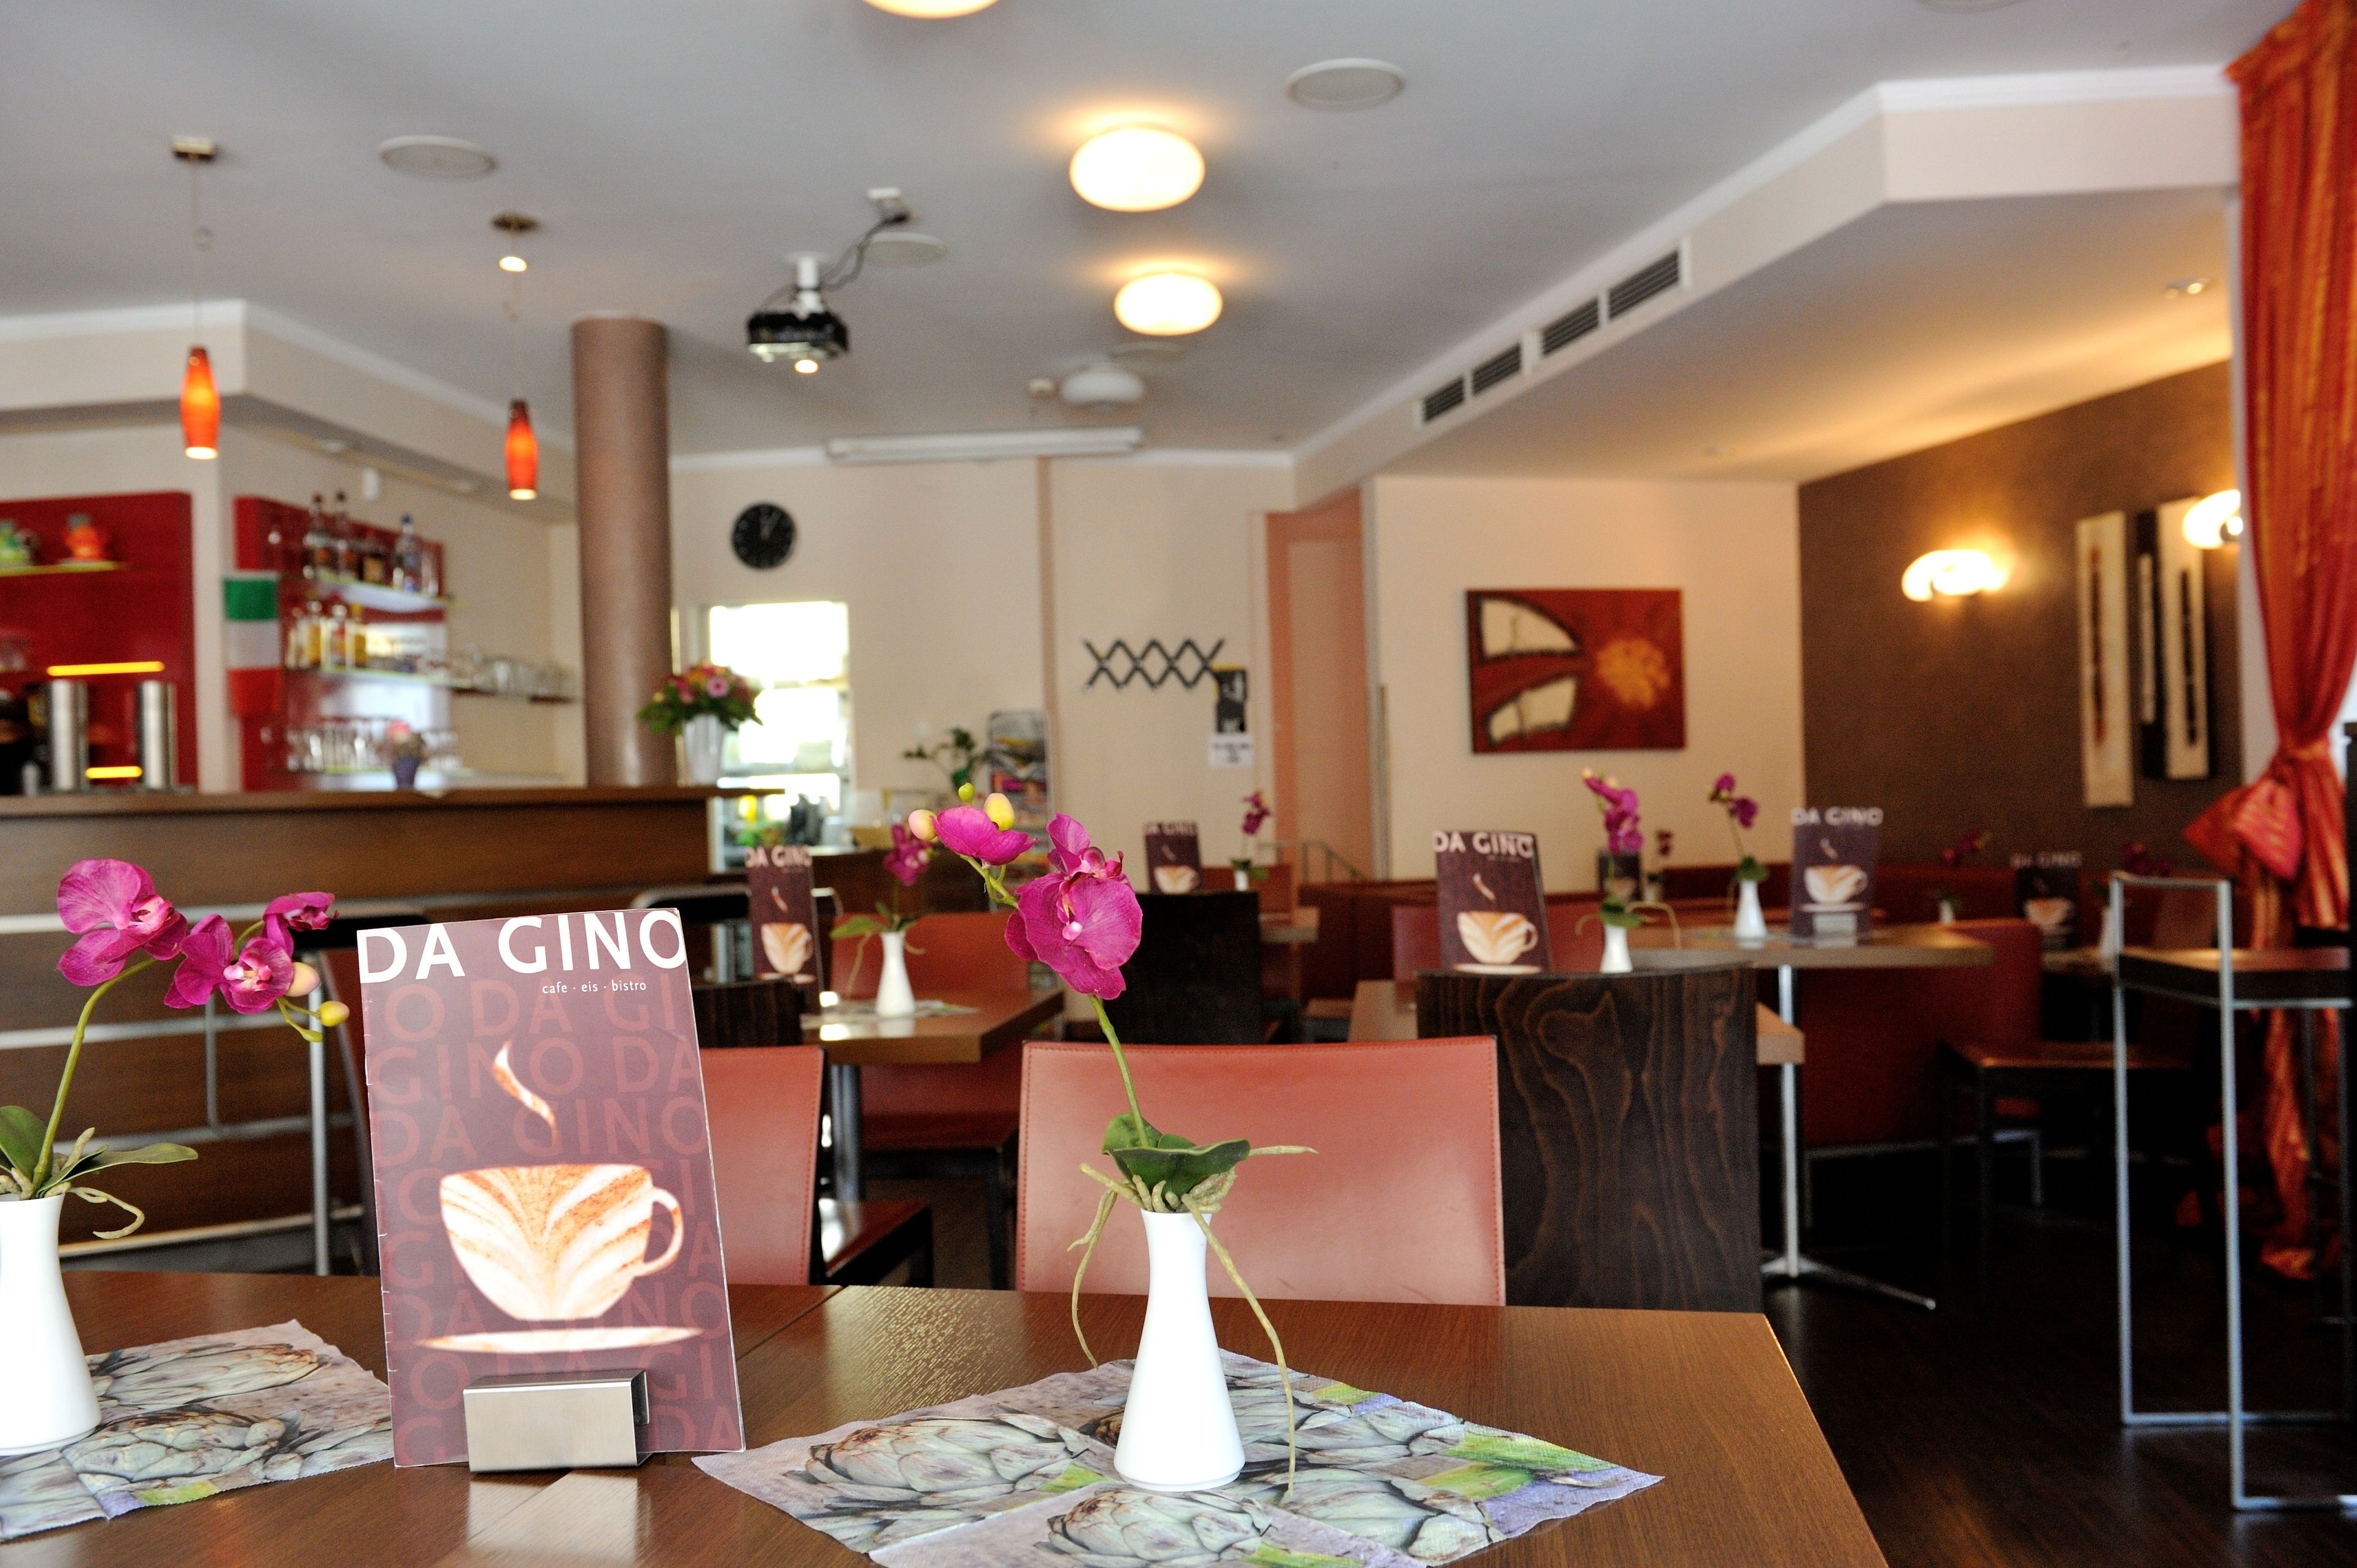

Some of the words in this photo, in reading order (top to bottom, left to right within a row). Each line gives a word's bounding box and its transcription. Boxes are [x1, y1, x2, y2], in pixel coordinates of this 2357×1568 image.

[1433, 831, 1466, 852] DA
[357, 924, 465, 983] DA
[498, 910, 686, 974] GINO
[542, 981, 568, 994] cafe
[581, 981, 598, 992] eis
[611, 979, 646, 991] bistro
[604, 972, 694, 1032] GI
